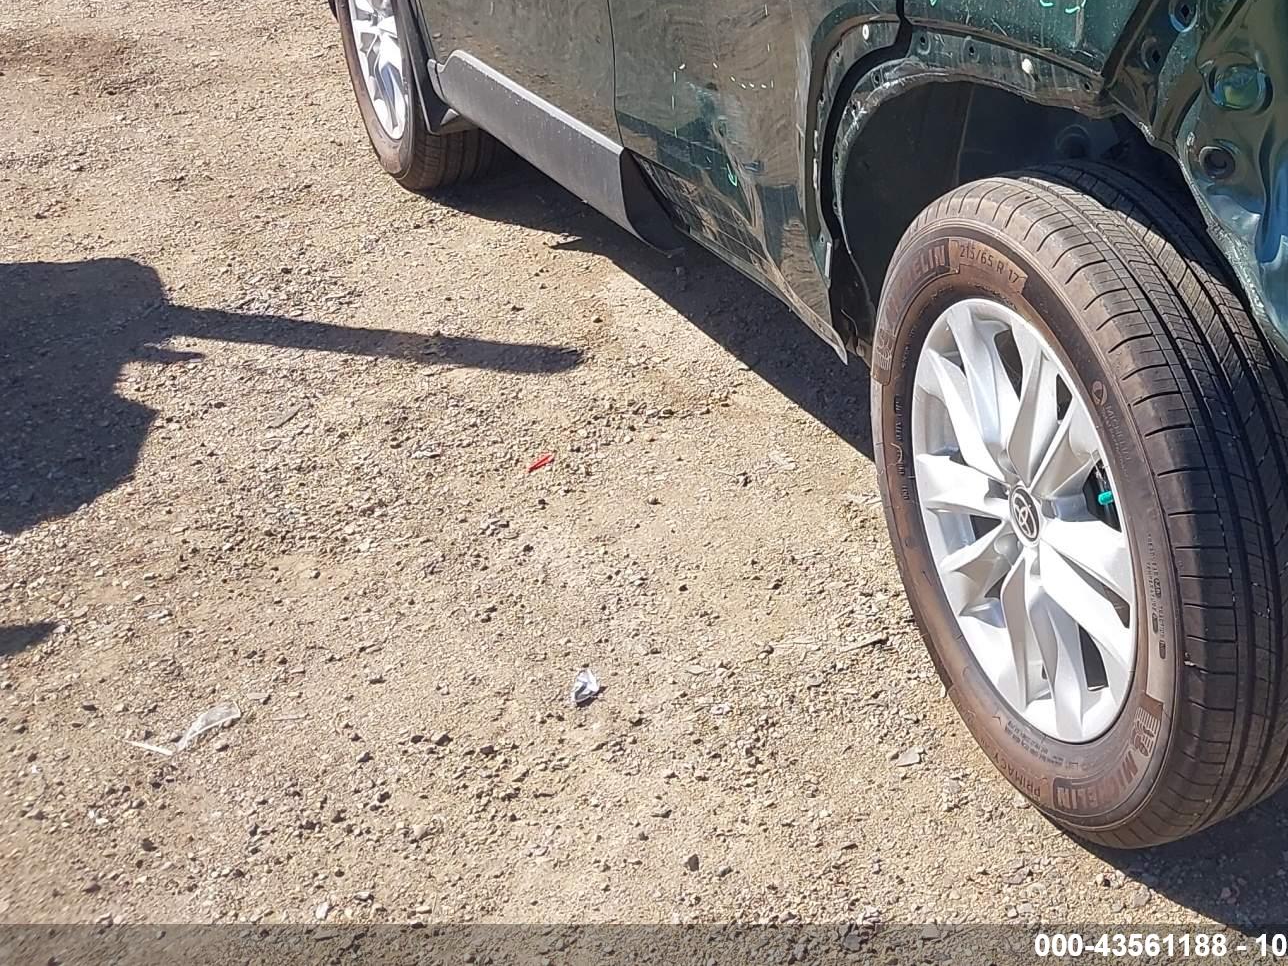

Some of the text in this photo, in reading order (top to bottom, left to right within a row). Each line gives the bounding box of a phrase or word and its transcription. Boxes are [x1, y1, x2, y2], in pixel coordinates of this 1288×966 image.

[960, 245, 994, 268] 215/65
[1008, 269, 1020, 284] 17
[993, 751, 1041, 798] PRIMACY
